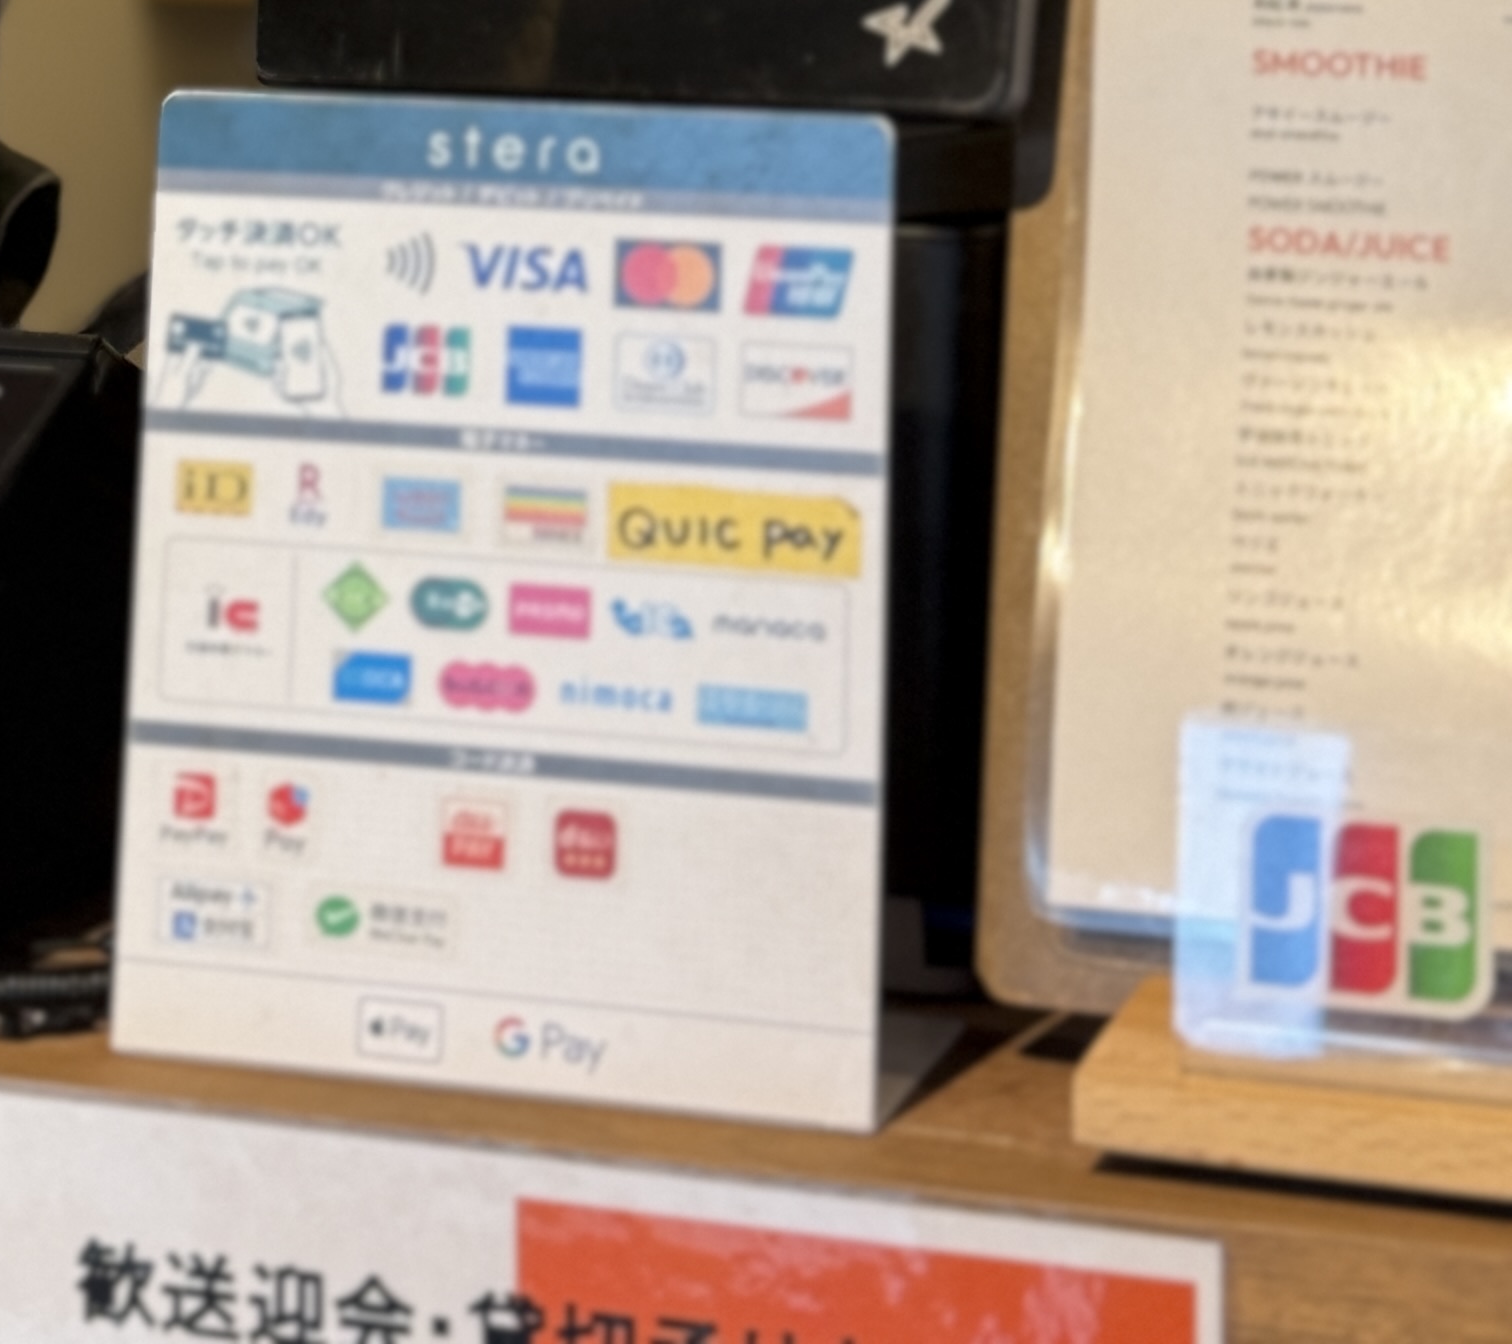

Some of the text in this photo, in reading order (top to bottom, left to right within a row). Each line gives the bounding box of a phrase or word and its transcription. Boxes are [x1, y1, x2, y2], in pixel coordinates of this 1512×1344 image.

[1251, 48, 1429, 83] SMOOTHIE
[426, 127, 602, 175] stera
[458, 242, 590, 294] VISA
[1247, 225, 1451, 265] SODA/JUICE
[617, 504, 741, 552] QUIC
[560, 672, 673, 714] nimoca
[539, 1020, 609, 1075] Pay
